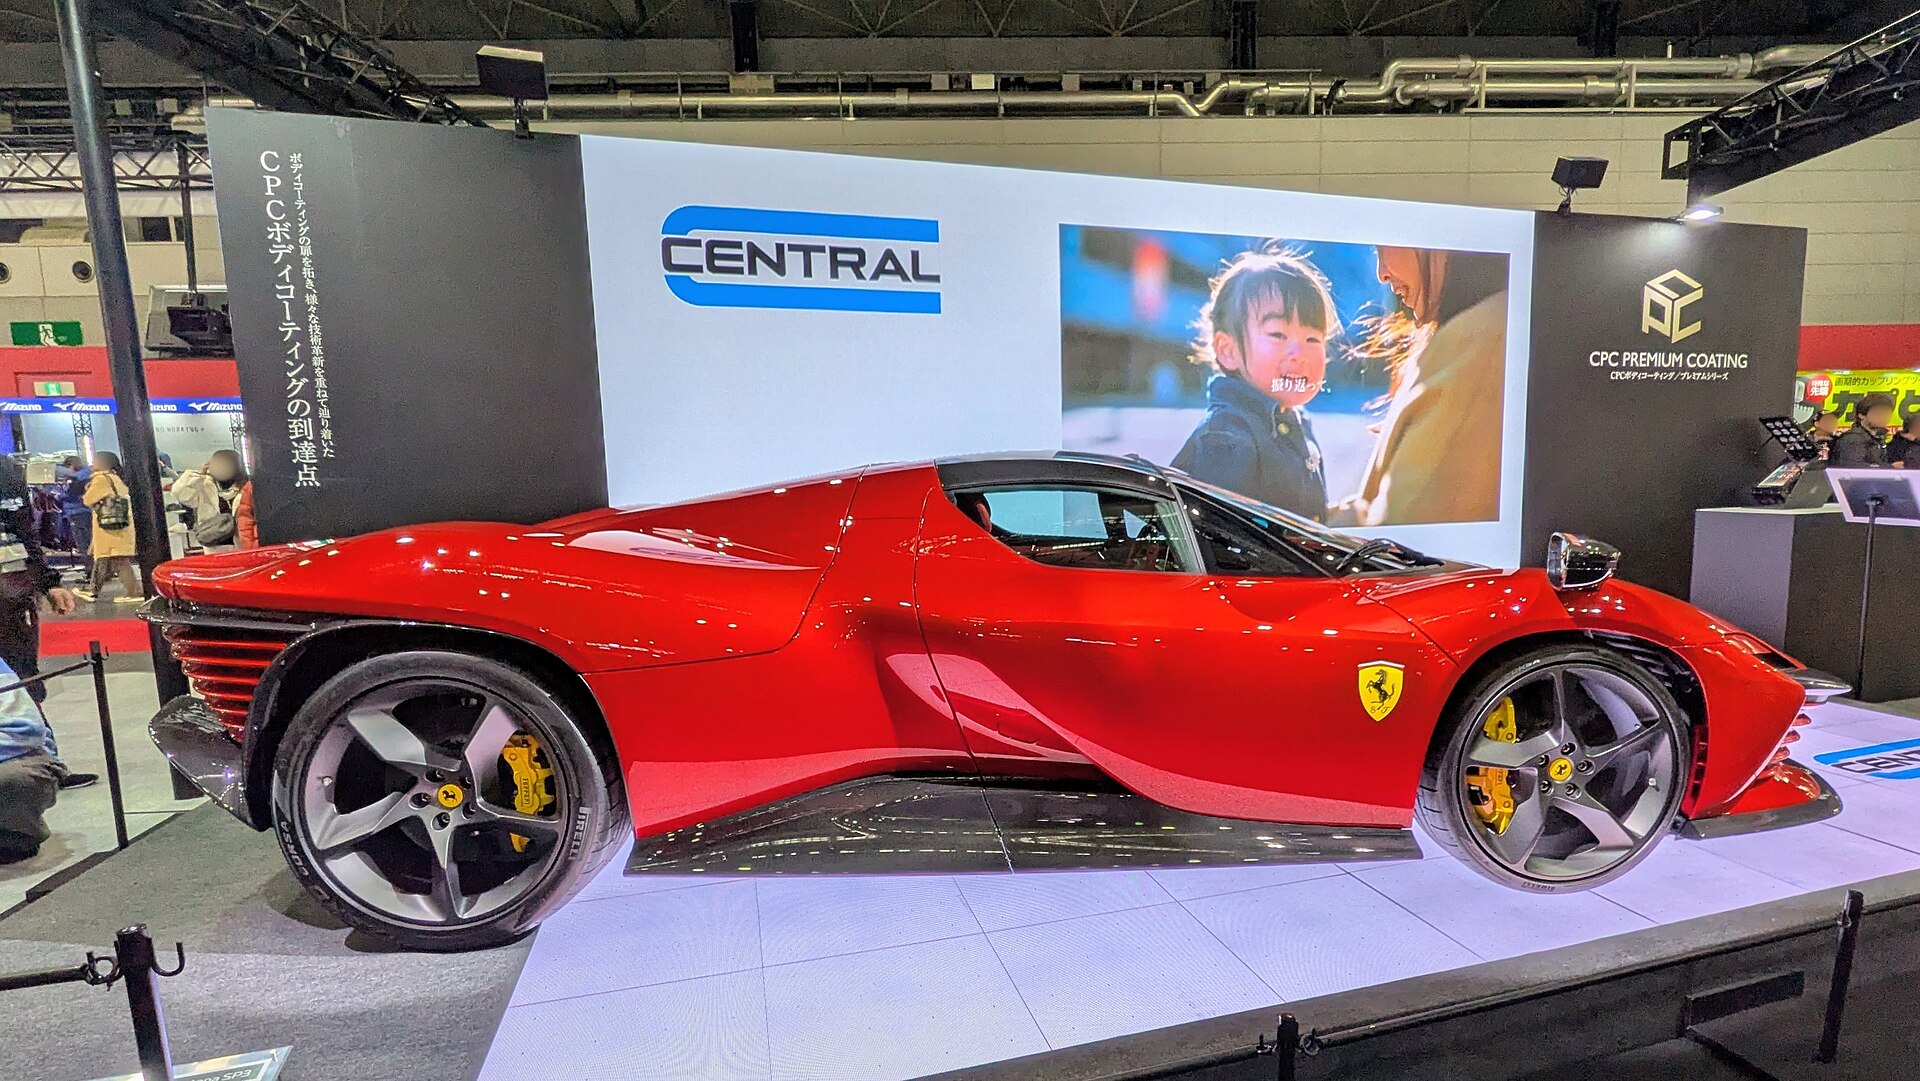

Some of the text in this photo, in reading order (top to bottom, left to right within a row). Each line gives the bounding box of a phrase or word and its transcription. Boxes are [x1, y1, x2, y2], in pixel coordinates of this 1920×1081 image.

[661, 237, 940, 283] CENTRAL
[260, 151, 320, 487] CPCボディコーティングの到達点
[1589, 351, 1748, 369] CPC PREMIUM COATING
[1835, 377, 1920, 387] 画期的カップリングツ
[1830, 748, 1920, 773] CEN
[280, 821, 309, 876] CORSA
[568, 806, 593, 860] PIRELLI
[222, 1069, 252, 1081] SP3
